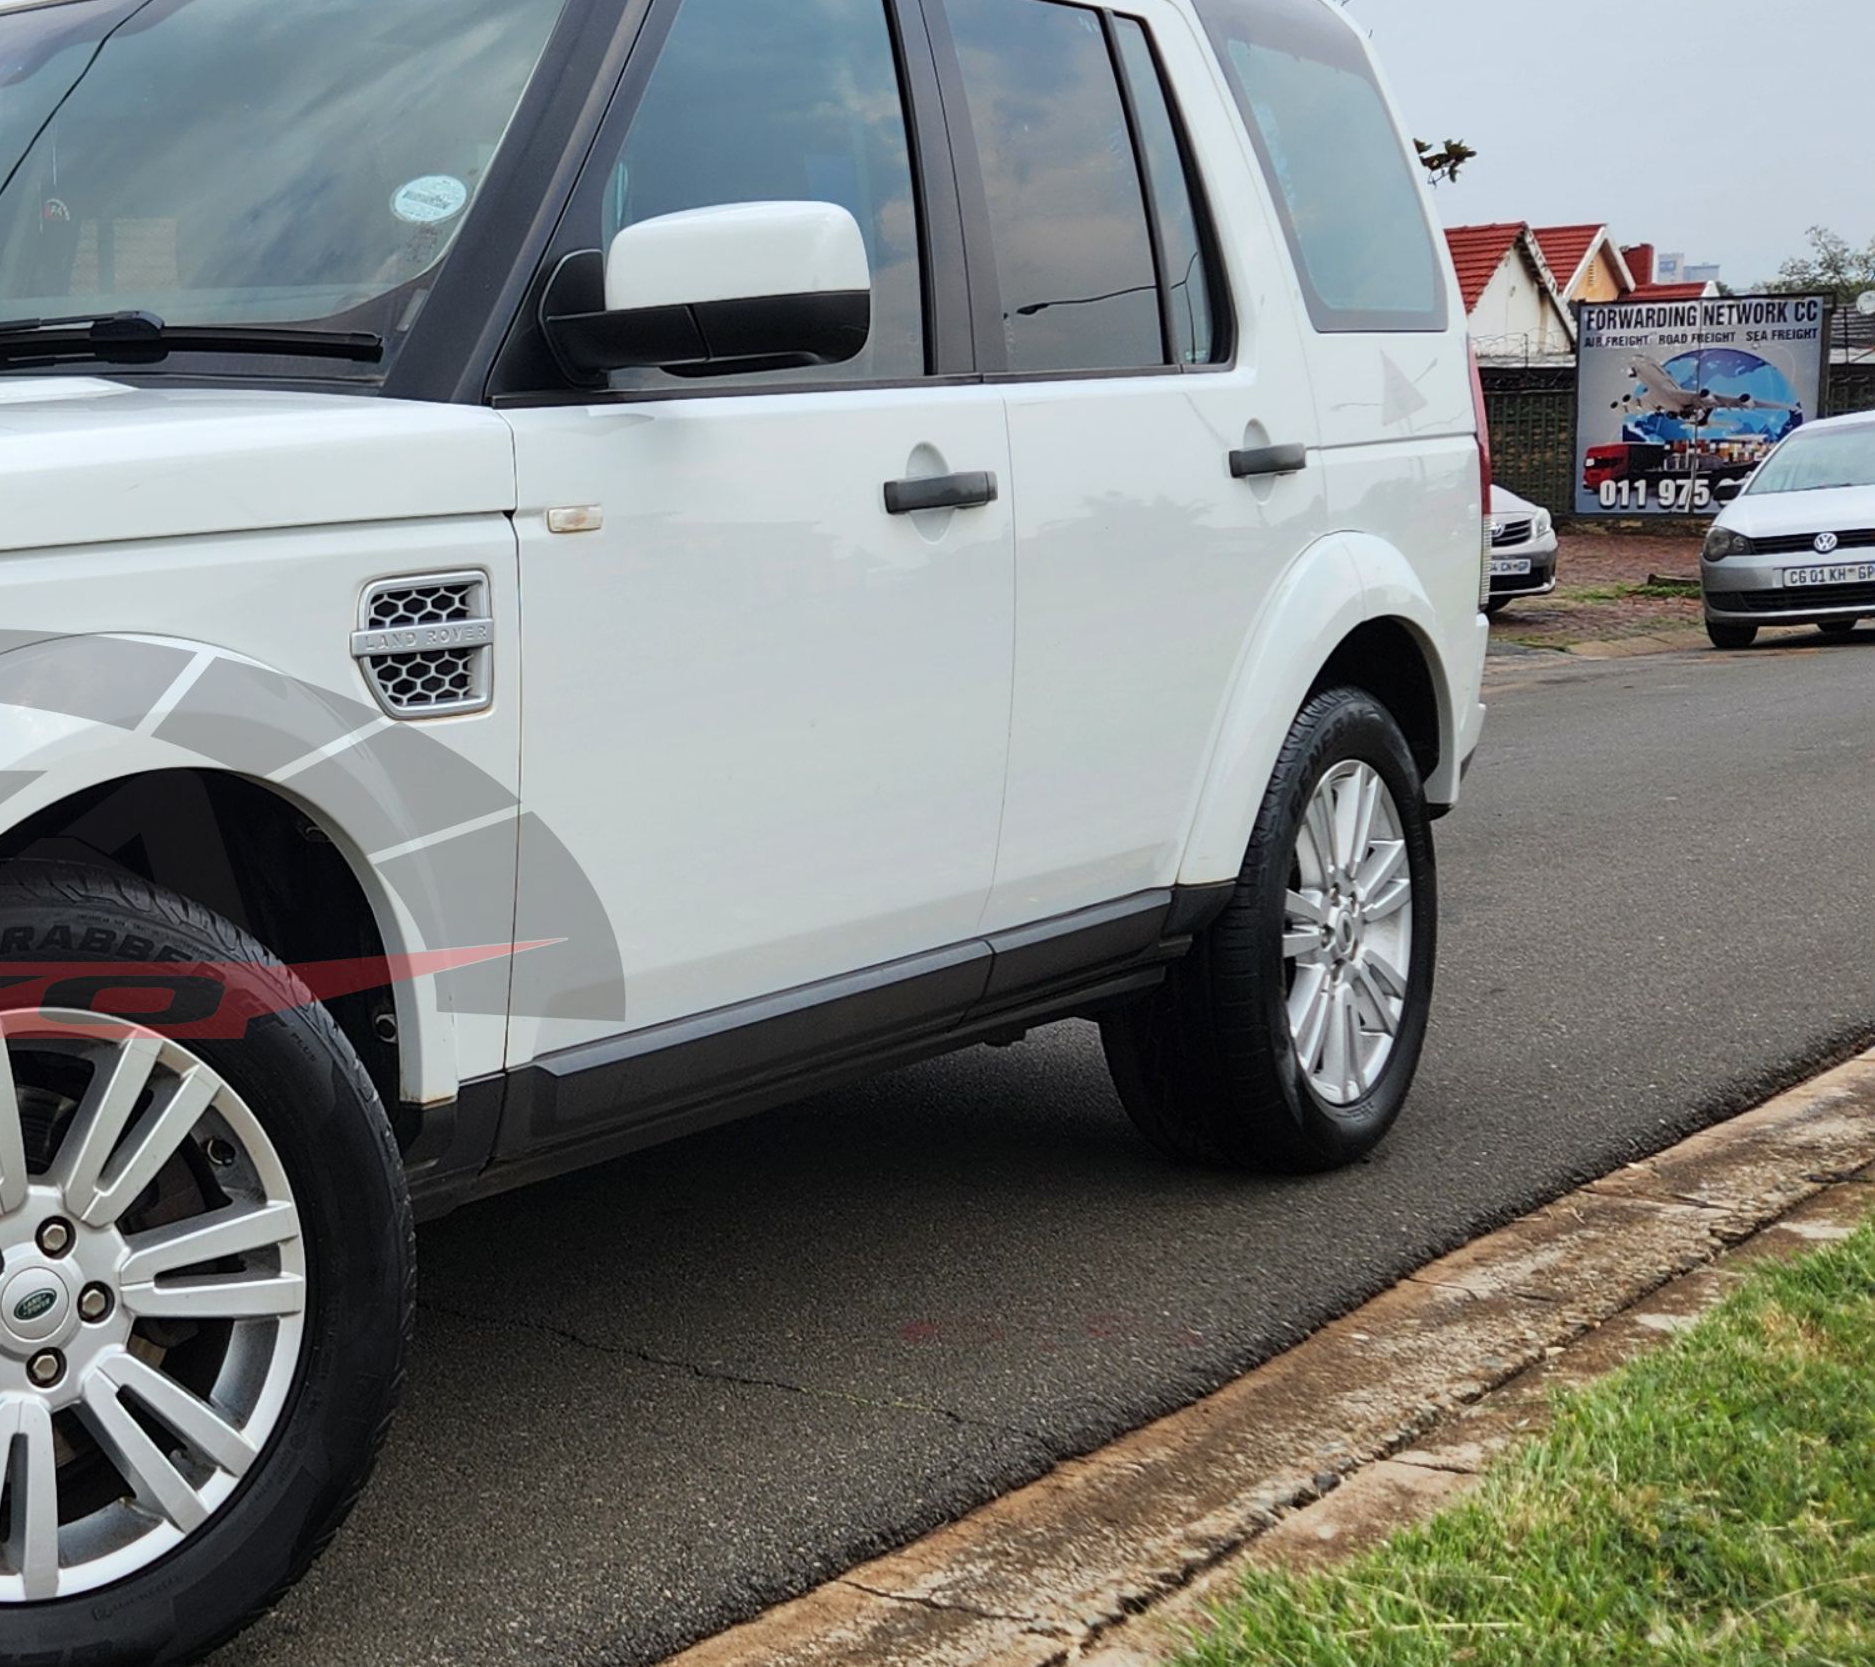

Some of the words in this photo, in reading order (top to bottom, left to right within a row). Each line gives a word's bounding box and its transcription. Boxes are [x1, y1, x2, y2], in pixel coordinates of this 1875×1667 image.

[1586, 305, 1697, 331] FORWARDING
[1703, 301, 1789, 327] NETWORK
[1794, 300, 1817, 322] CC
[1584, 336, 1602, 348] AIR
[1658, 333, 1688, 345] ROAD
[1690, 331, 1736, 344] FREIGHT
[1745, 330, 1767, 342] SEA
[1771, 328, 1817, 341] FREIGHT
[1600, 479, 1646, 506] 011
[1658, 479, 1710, 506] 975
[1829, 568, 1846, 581] KH
[365, 632, 416, 651] LAND
[427, 625, 487, 645] ROVER
